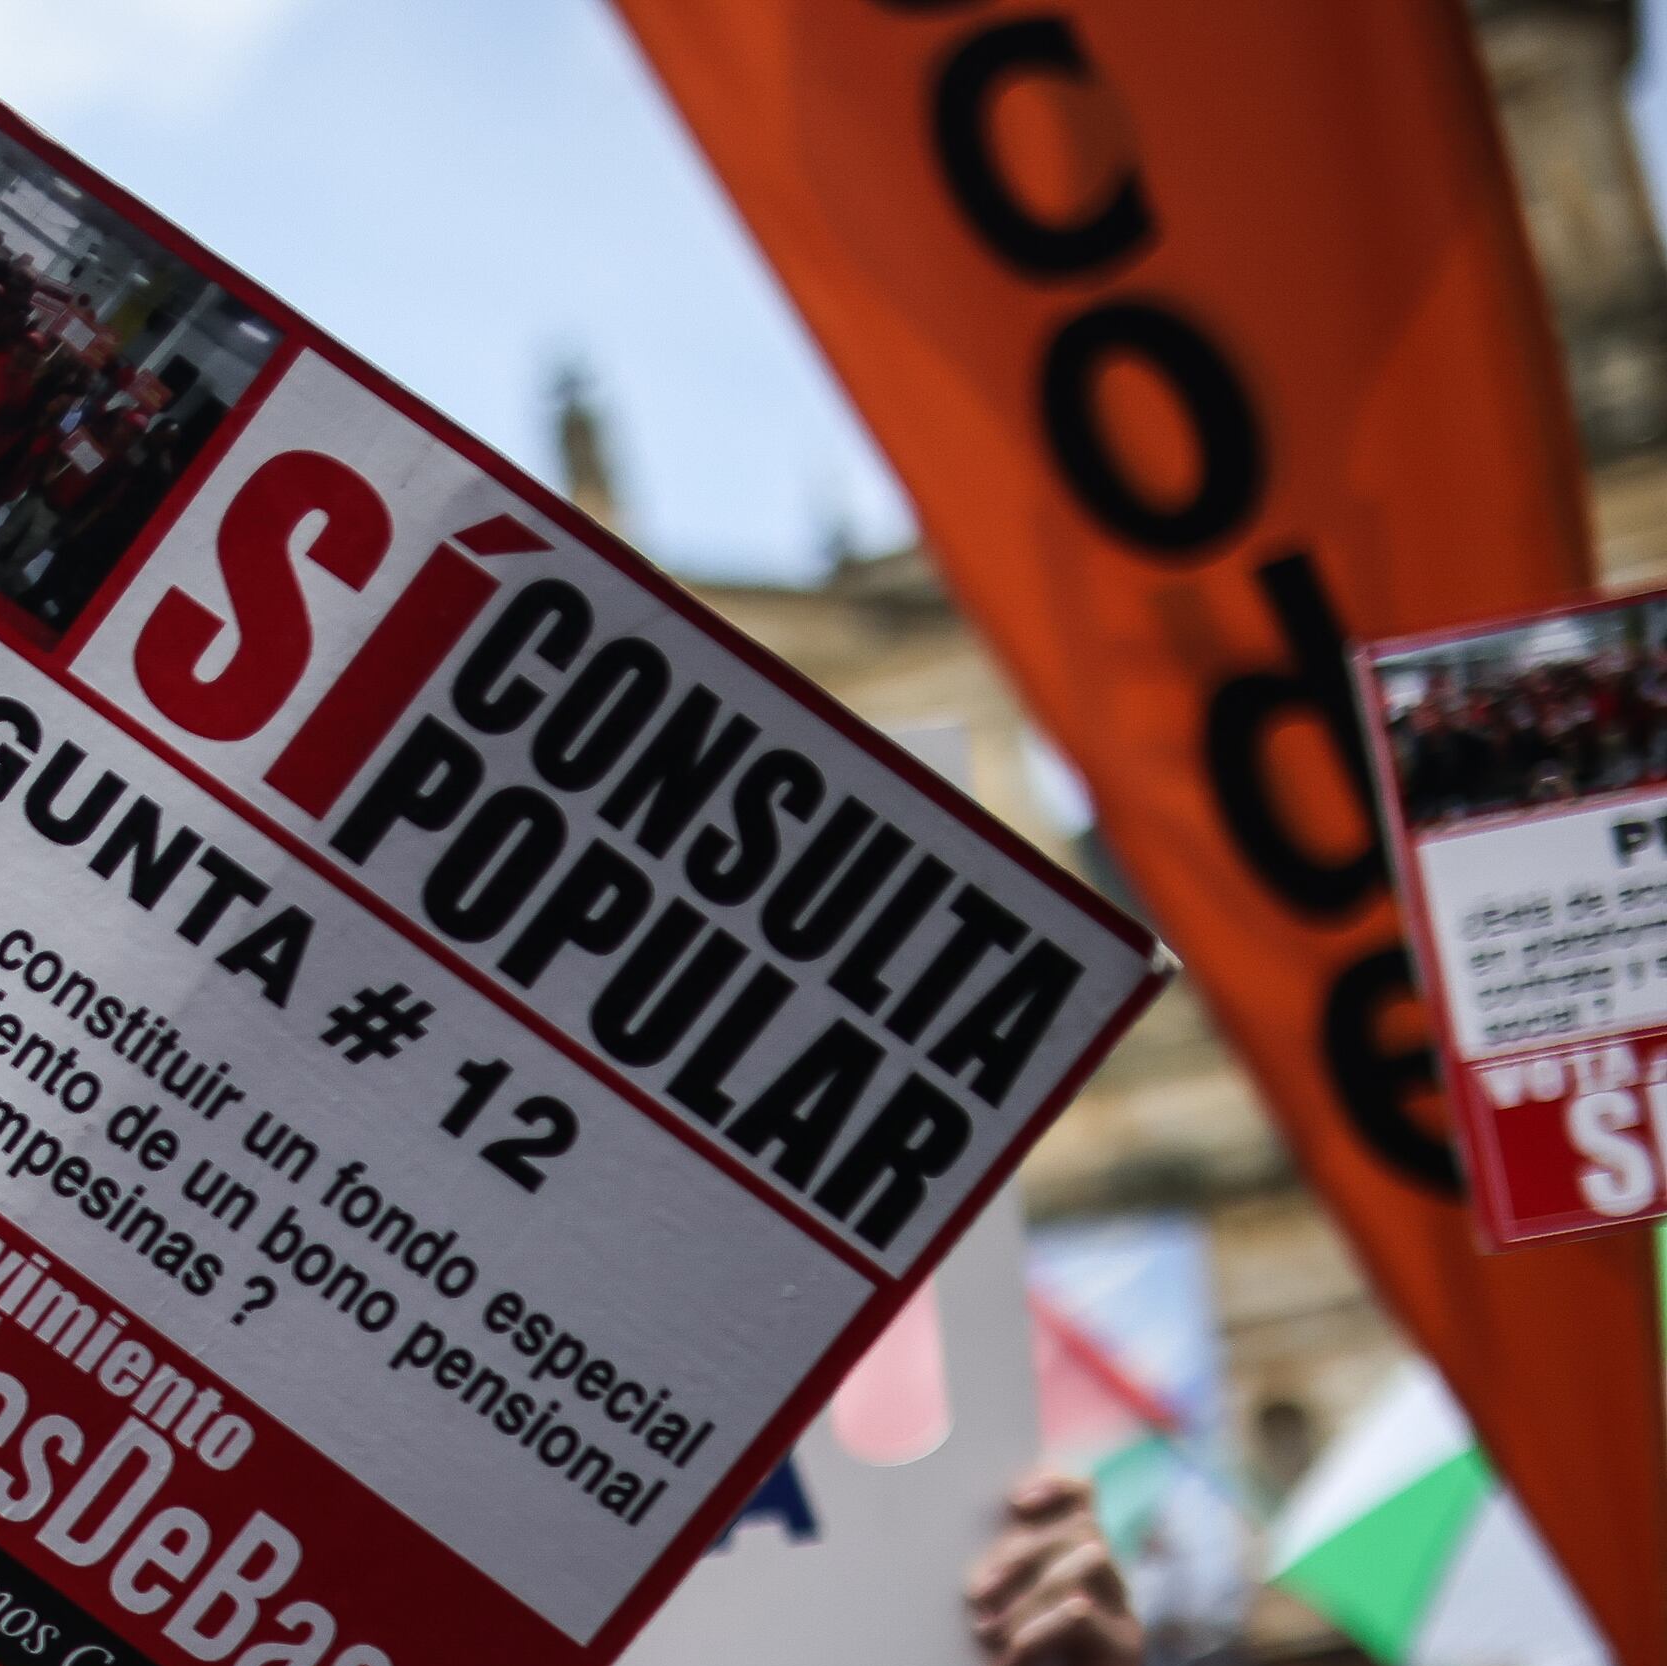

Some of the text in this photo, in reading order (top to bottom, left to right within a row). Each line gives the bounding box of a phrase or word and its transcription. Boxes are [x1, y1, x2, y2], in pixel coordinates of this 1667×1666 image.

[134, 450, 556, 816] SÍ
[327, 712, 976, 1254] POPULAR
[447, 577, 1087, 1109] CONSULTA
[317, 982, 437, 1065] #
[437, 1057, 581, 1195] 12
[106, 1104, 181, 1172] de
[181, 1158, 259, 1233] un
[256, 1205, 400, 1334] bono
[387, 1320, 670, 1528] pensional
[229, 1275, 278, 1327] ?
[241, 1110, 320, 1185] un
[319, 1160, 480, 1300] fondo
[481, 1291, 717, 1488] especial
